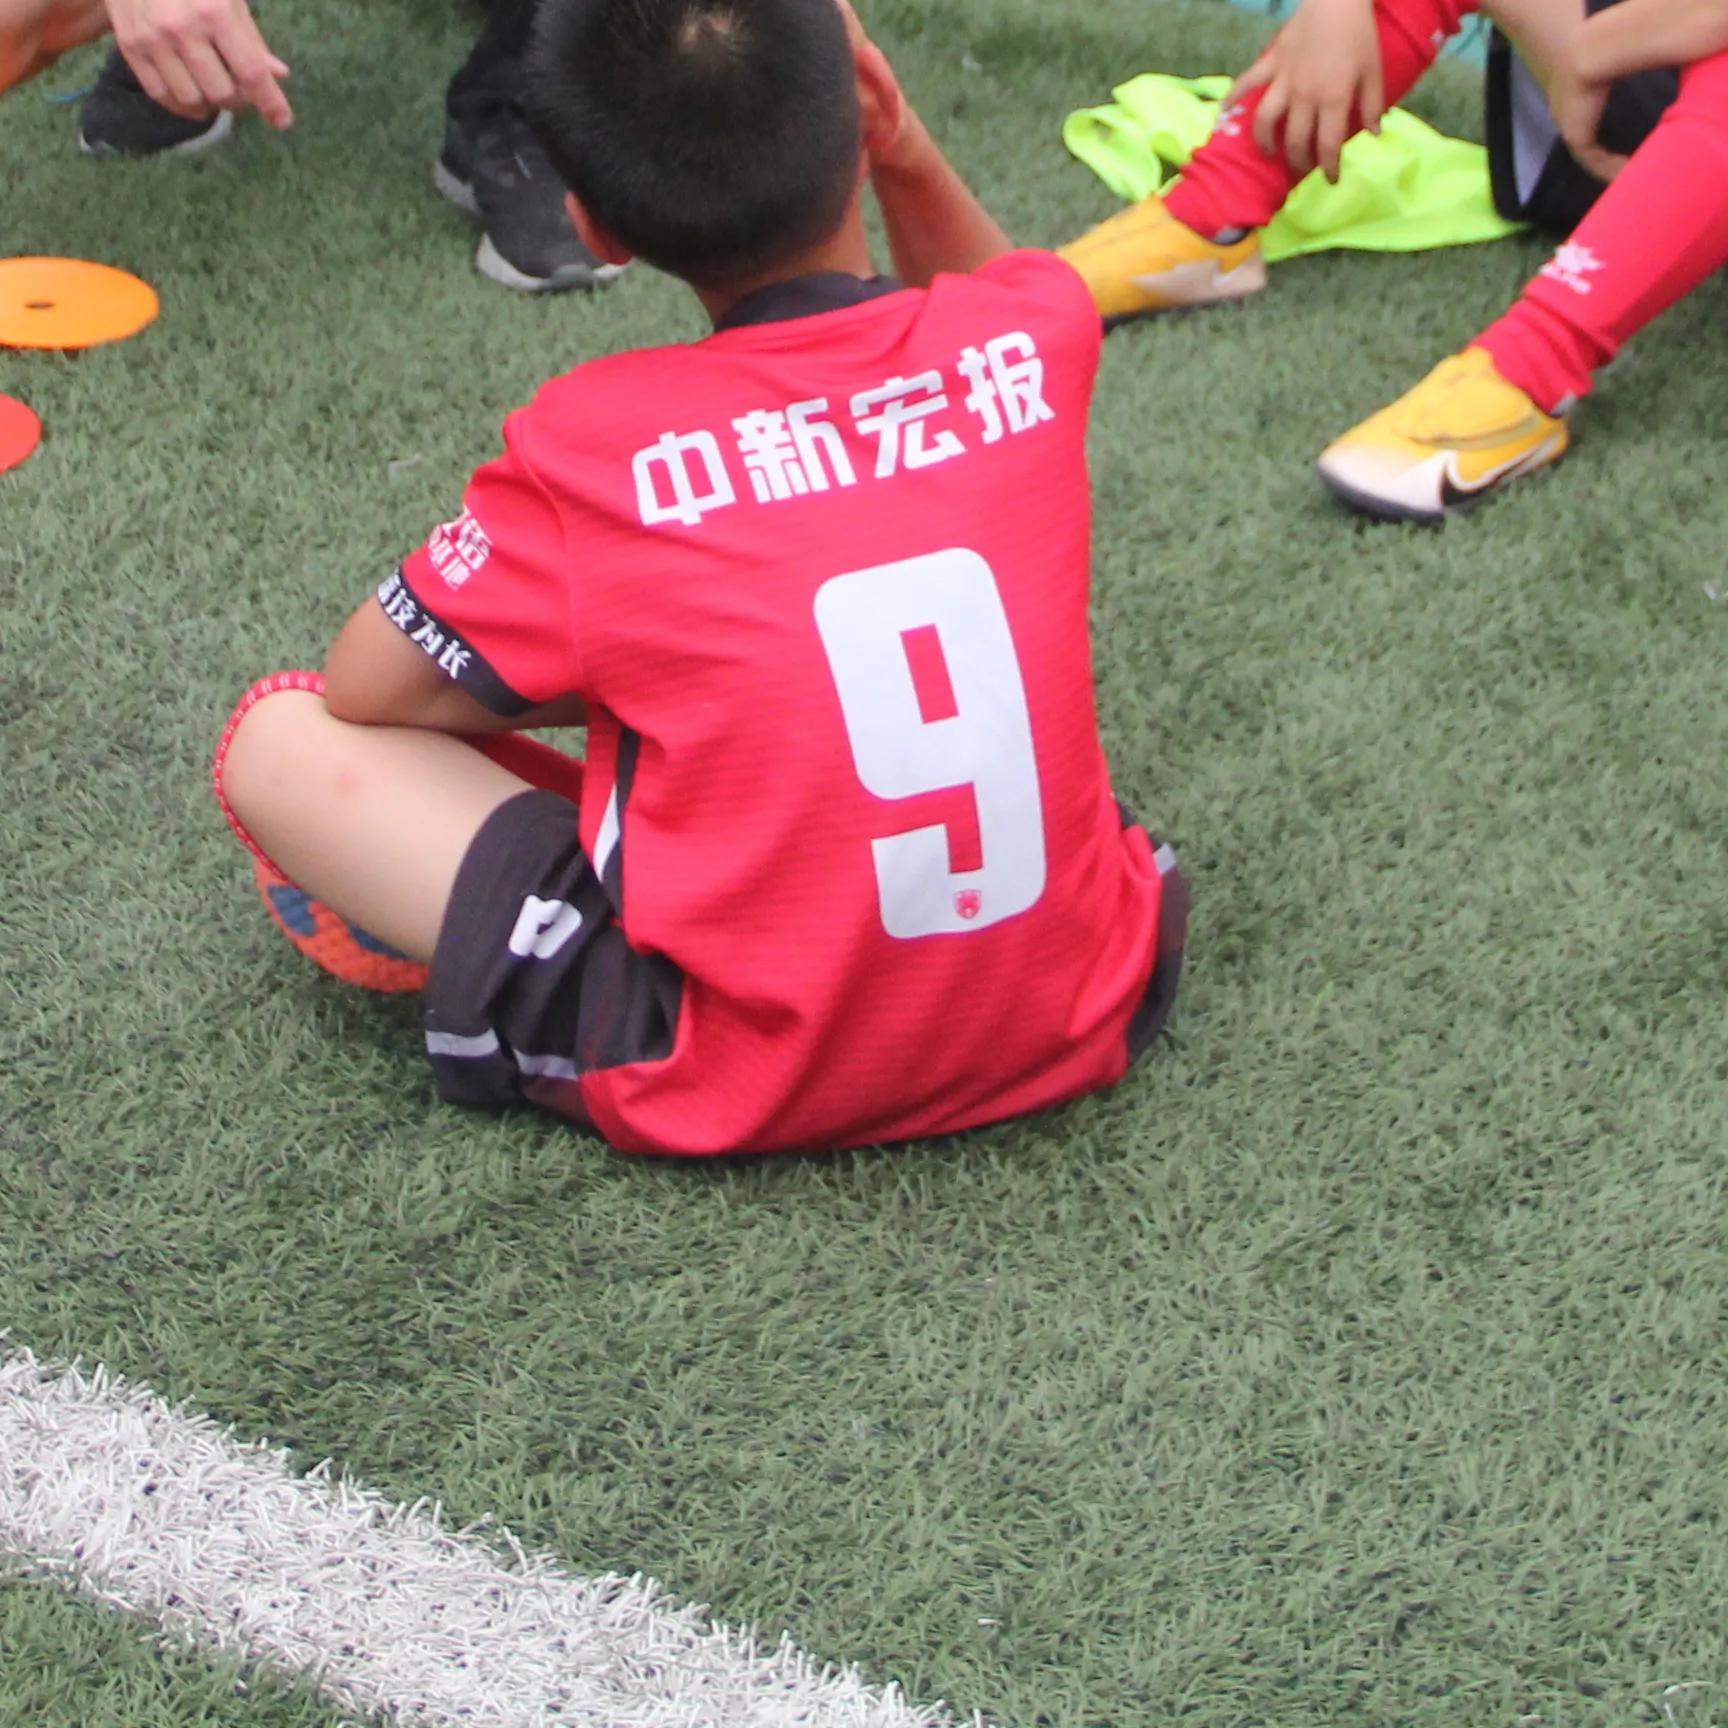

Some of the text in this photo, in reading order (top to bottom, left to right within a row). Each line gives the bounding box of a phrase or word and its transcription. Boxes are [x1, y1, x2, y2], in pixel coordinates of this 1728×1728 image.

[631, 331, 1055, 527] 中新宏报
[813, 547, 1047, 939] 9
